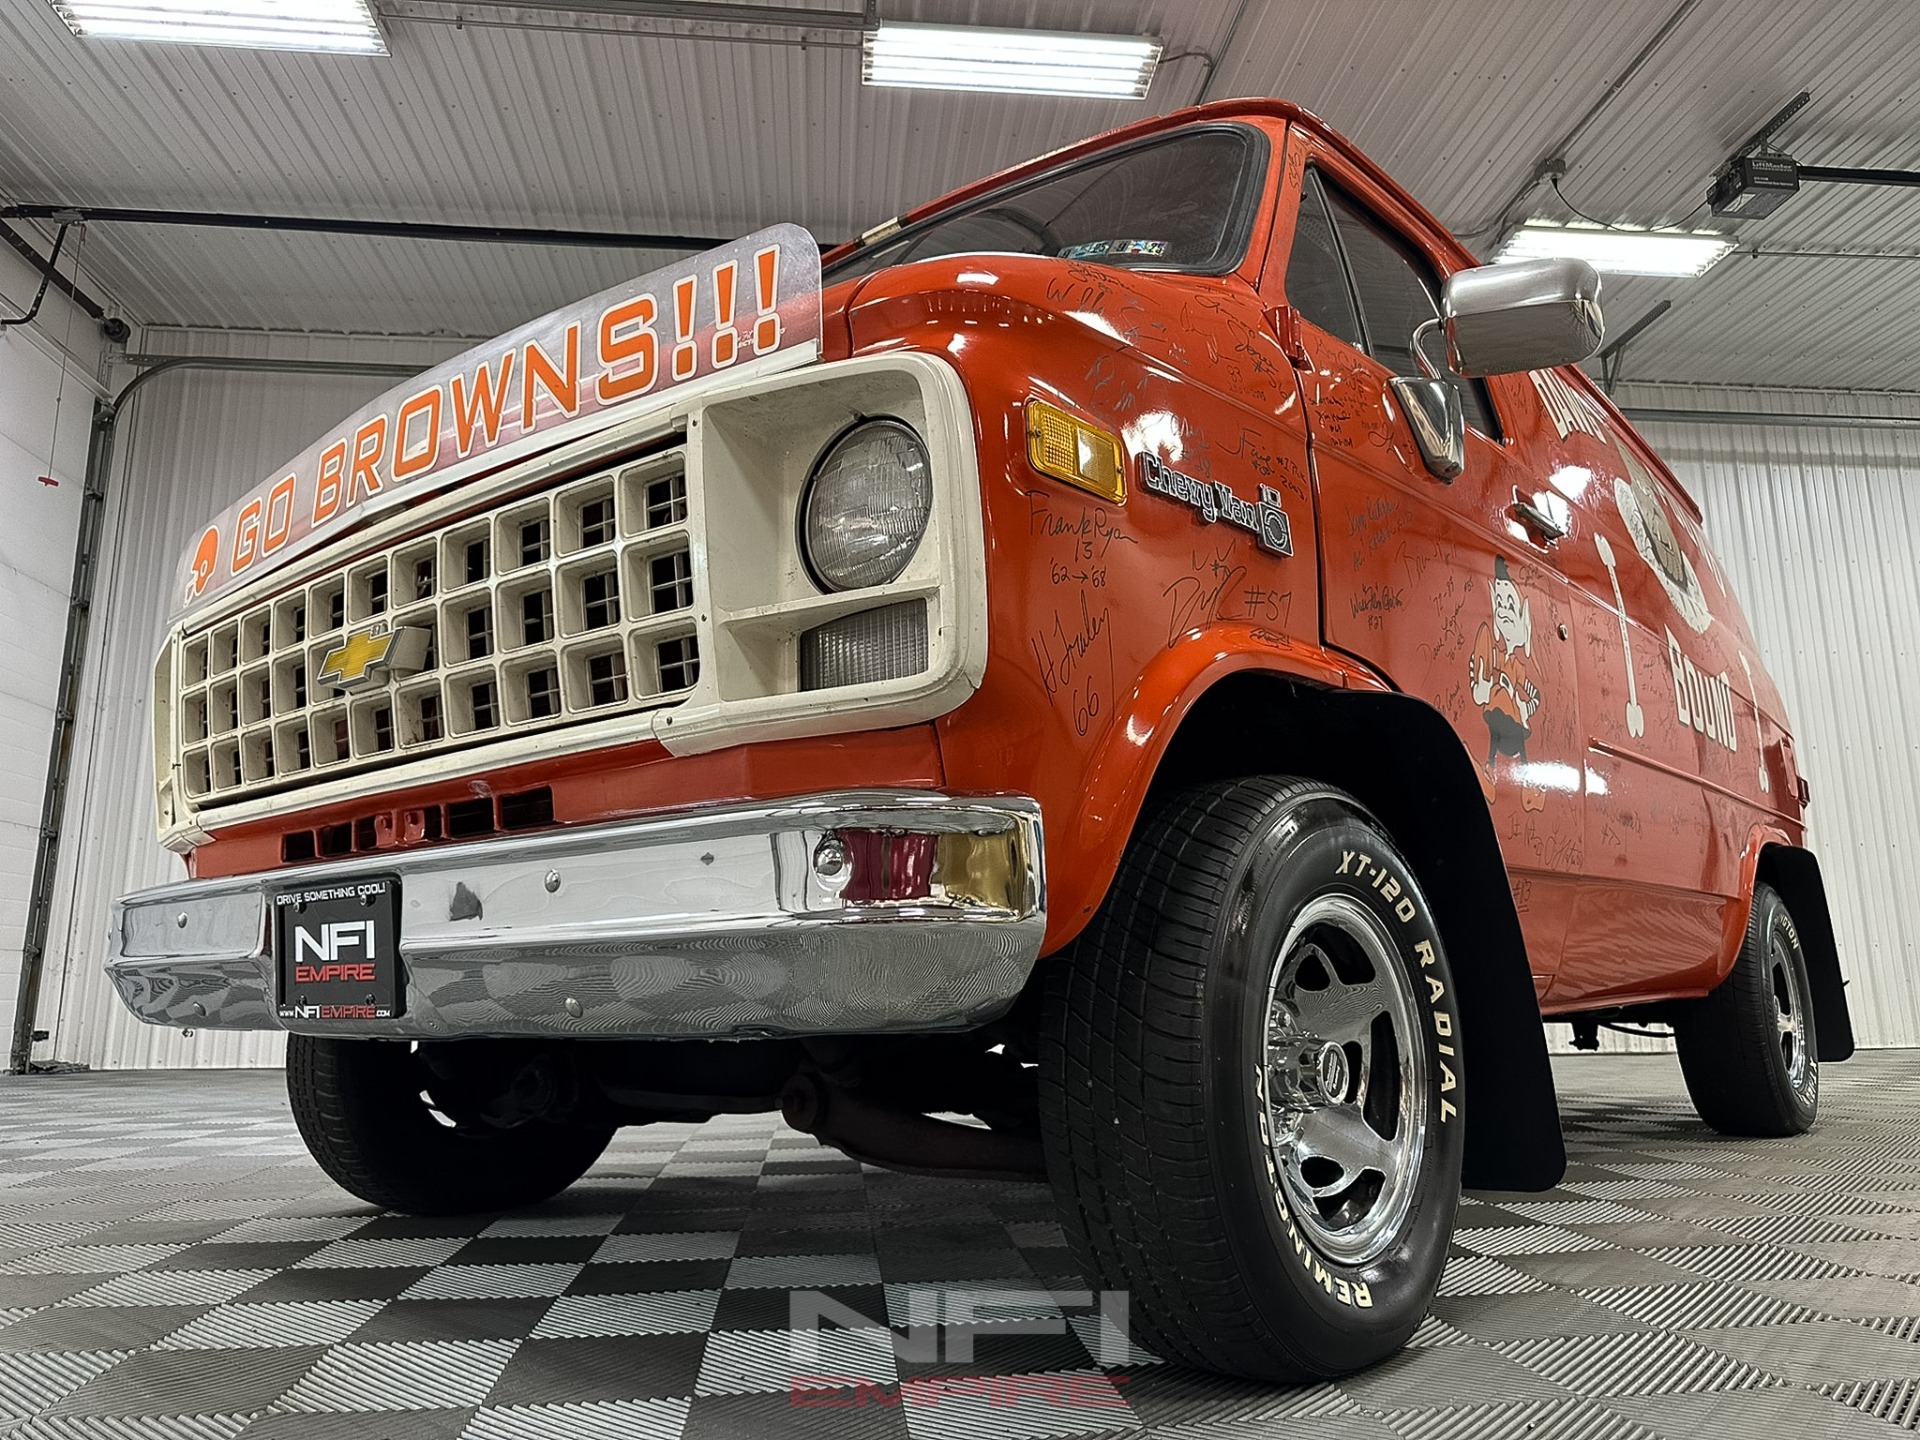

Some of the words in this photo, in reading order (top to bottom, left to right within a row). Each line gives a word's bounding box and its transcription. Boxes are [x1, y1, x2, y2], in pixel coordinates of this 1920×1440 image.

[230, 471, 297, 577] GO
[310, 243, 782, 528] BROWNS!!!
[1024, 490, 1091, 537] Frank
[1093, 506, 1139, 558] Ryan
[1144, 452, 1217, 524] Chevy
[1214, 481, 1261, 533] Van
[1075, 539, 1093, 563] 13
[1244, 584, 1293, 628] #57
[1073, 676, 1100, 737] 66
[1663, 623, 1738, 753] BOUND
[276, 893, 303, 905] DRIVE
[304, 887, 355, 902] SOMETHING
[357, 882, 386, 895] COOL!
[1335, 850, 1416, 924] XT-120
[295, 920, 375, 962] NFI
[295, 963, 377, 982] EMPIRE
[1413, 938, 1458, 1124] RADIAL
[1253, 1063, 1374, 1309] REMINGTON
